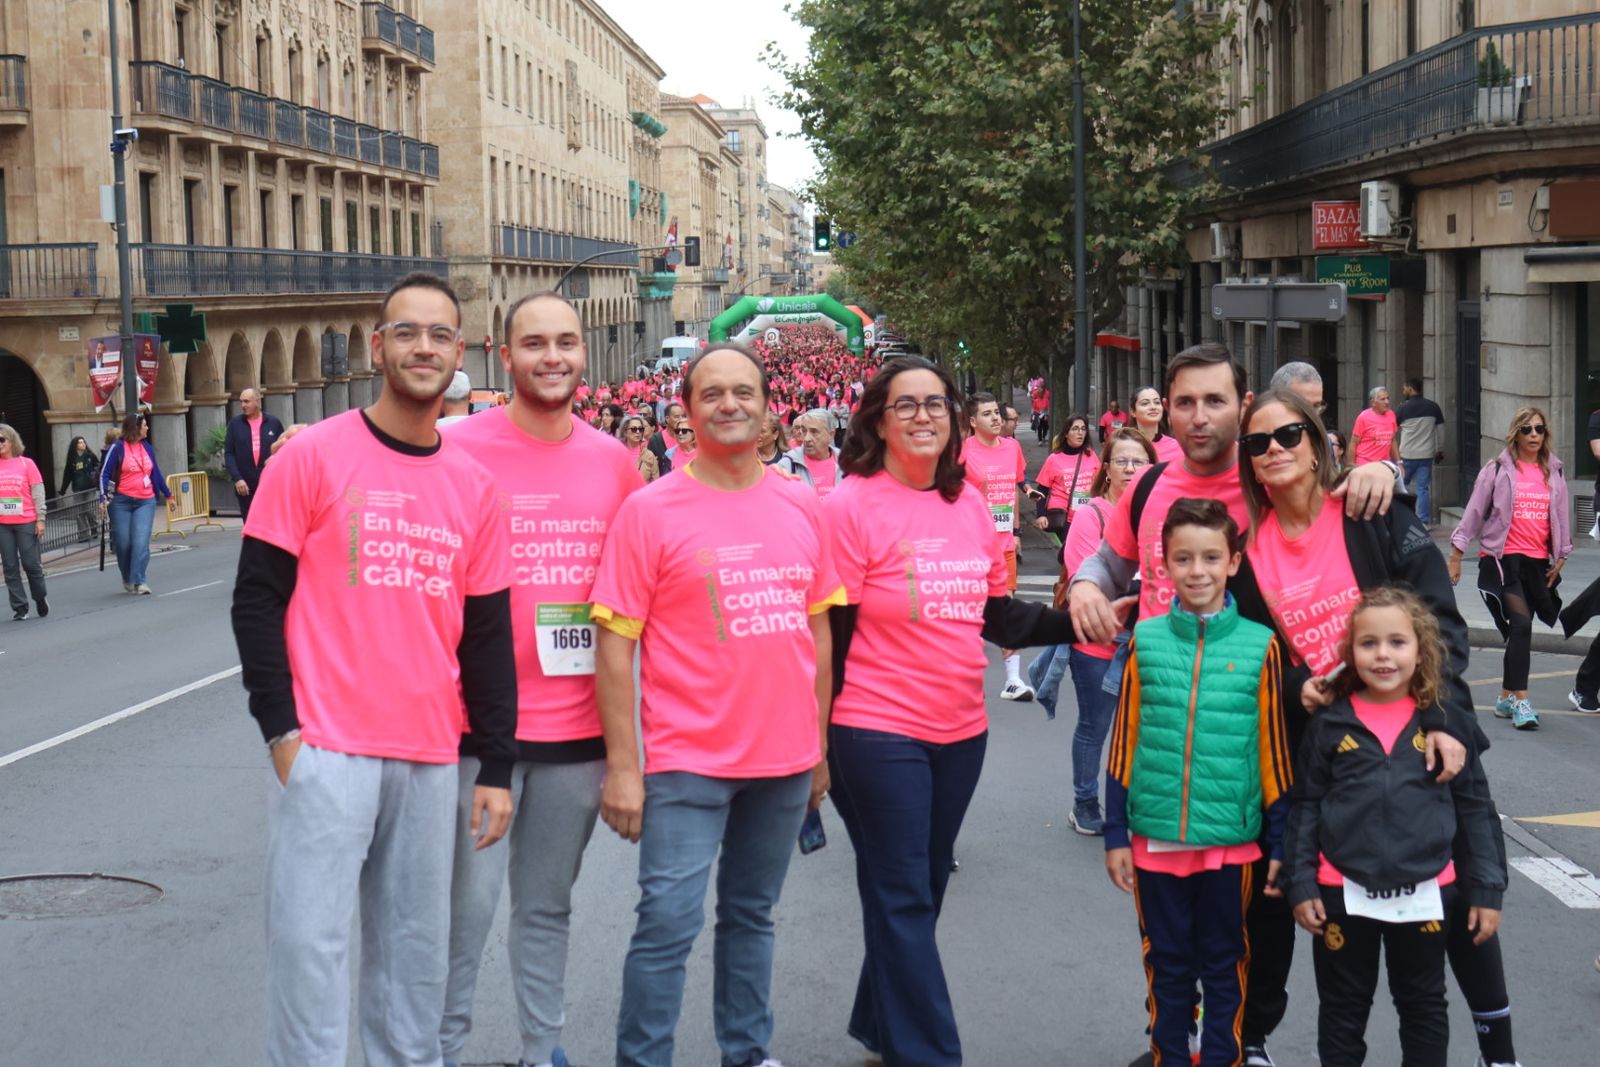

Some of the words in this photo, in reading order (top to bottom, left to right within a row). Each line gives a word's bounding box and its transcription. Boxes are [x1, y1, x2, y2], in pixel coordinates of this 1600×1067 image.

[1344, 264, 1361, 273] PUB
[776, 301, 817, 313] Unicaja
[364, 512, 391, 532] En
[1513, 509, 1548, 520] cánce
[511, 516, 535, 534] En
[363, 540, 434, 566] conra
[511, 538, 586, 558] contra
[515, 559, 597, 585] cánce
[915, 557, 938, 574] En
[718, 568, 746, 586] En
[919, 576, 980, 595] contra
[723, 585, 794, 611] contra
[922, 595, 986, 620] cánce
[1281, 608, 1308, 629] En
[1308, 586, 1361, 618] marc
[729, 607, 808, 638] cánce
[1292, 612, 1350, 649] contr
[551, 628, 592, 649] 1669
